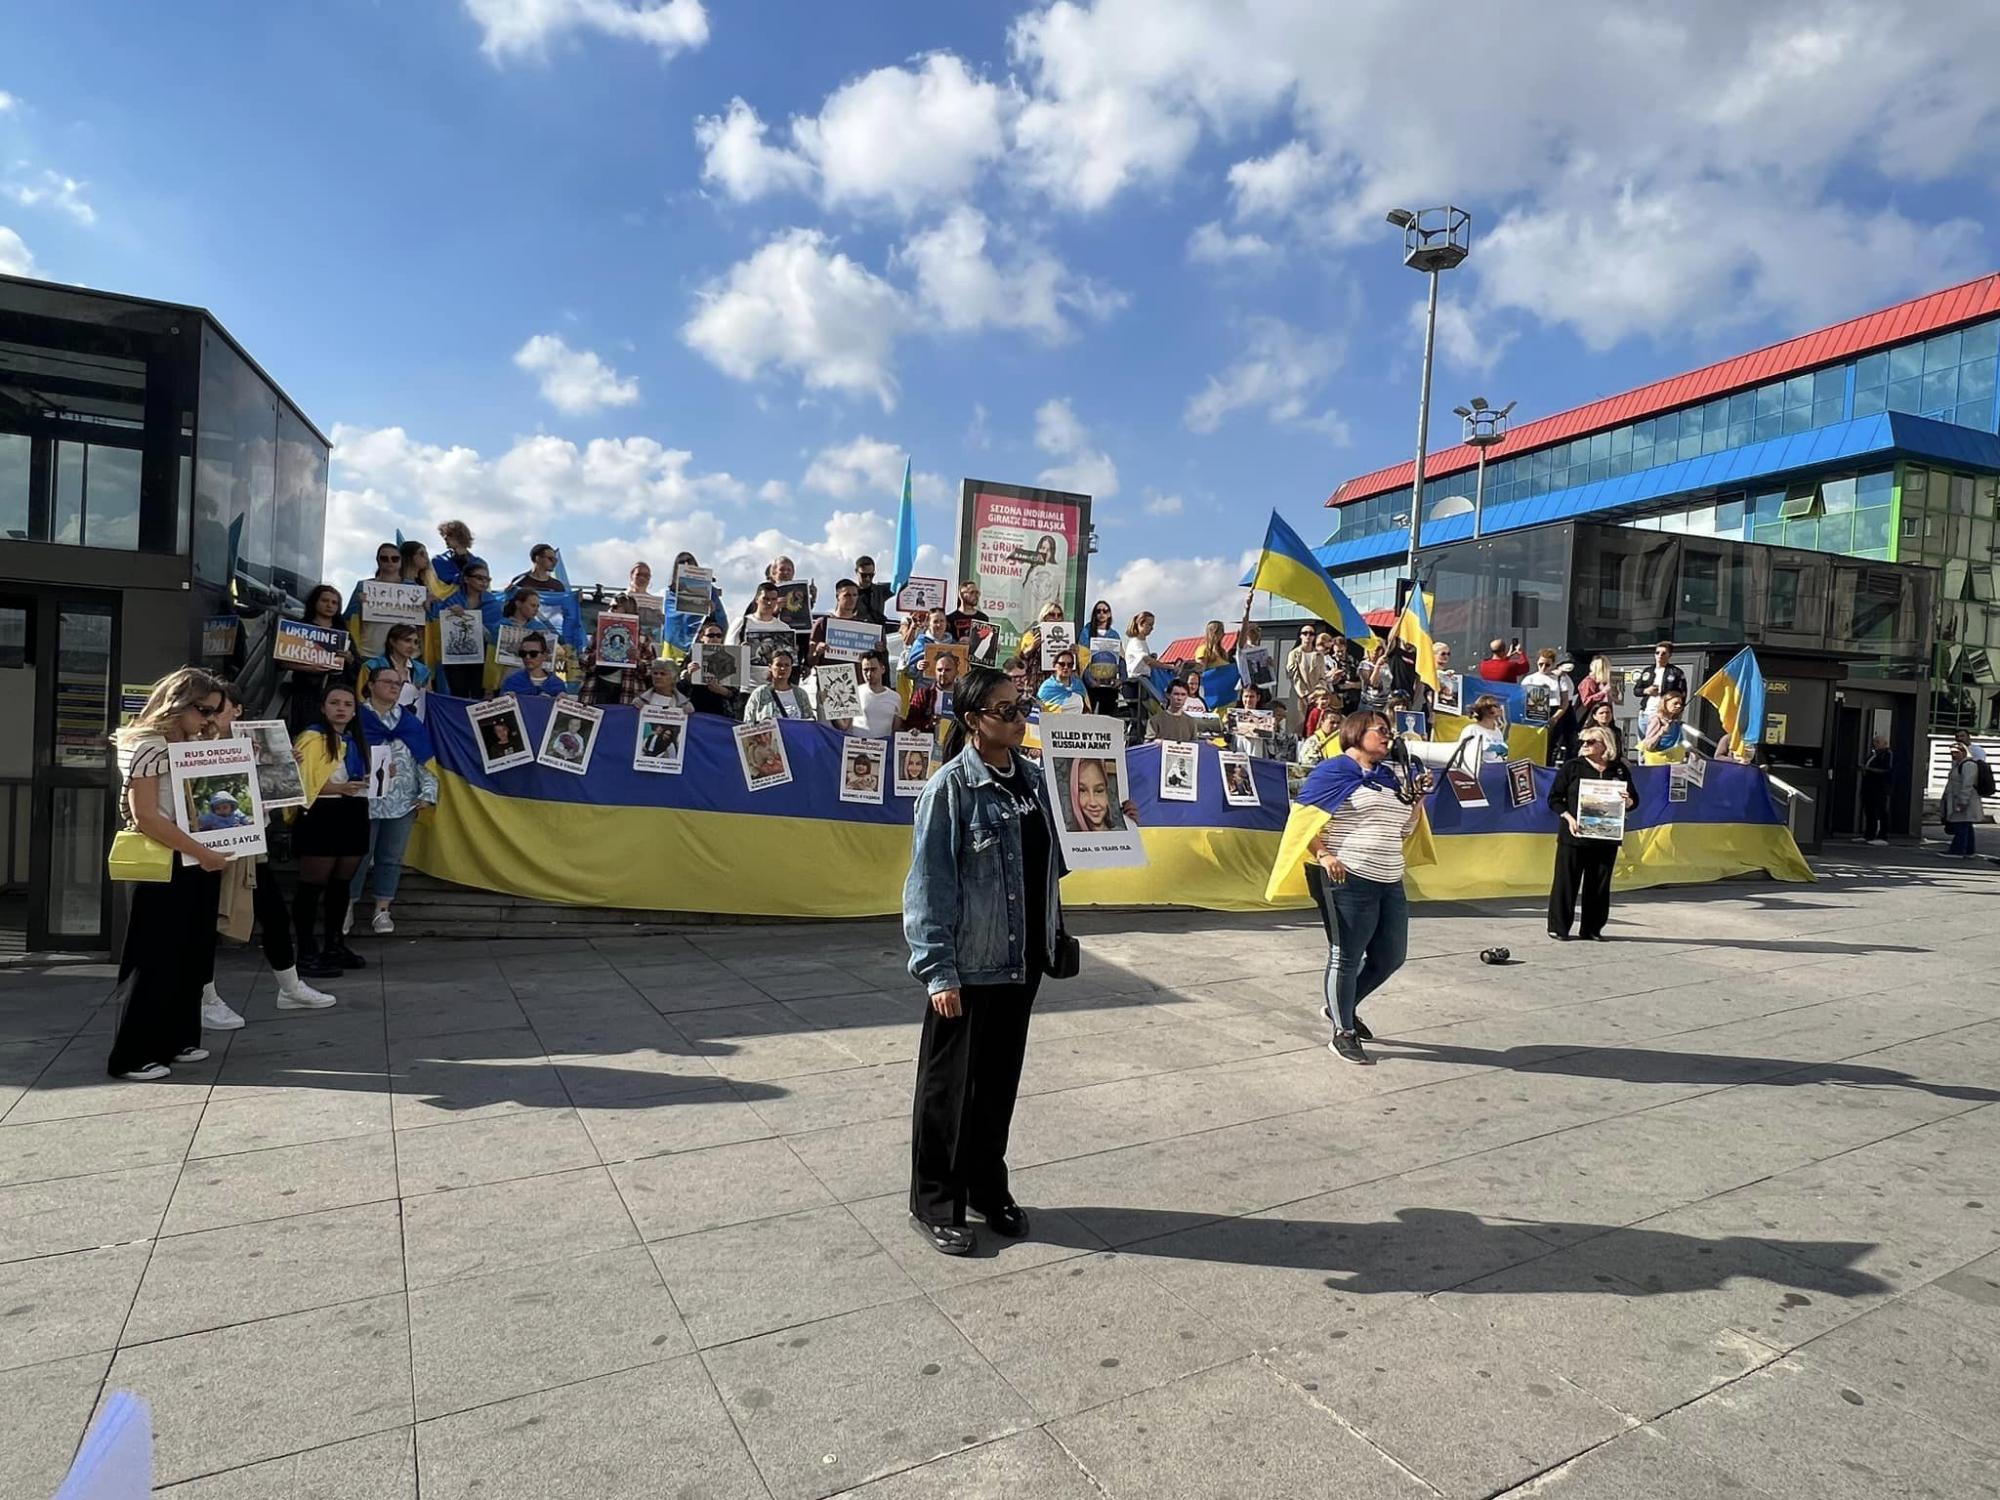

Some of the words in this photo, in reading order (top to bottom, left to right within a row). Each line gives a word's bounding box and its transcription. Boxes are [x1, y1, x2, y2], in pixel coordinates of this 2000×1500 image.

[990, 504, 1021, 516] SEZONA
[981, 553, 999, 563] NET
[983, 600, 1005, 611] 129
[286, 625, 338, 645] UKRAINE
[278, 642, 339, 666] UKRAINE
[1051, 731, 1080, 741] KILLED
[1082, 732, 1093, 741] BY
[1095, 732, 1112, 742] THE
[1052, 740, 1086, 749] RUSSIAN
[1088, 741, 1112, 750] ARMY
[206, 748, 242, 757] ORDUSU
[175, 758, 218, 768] TARAFINDAN
[238, 834, 261, 844] AYLIK
